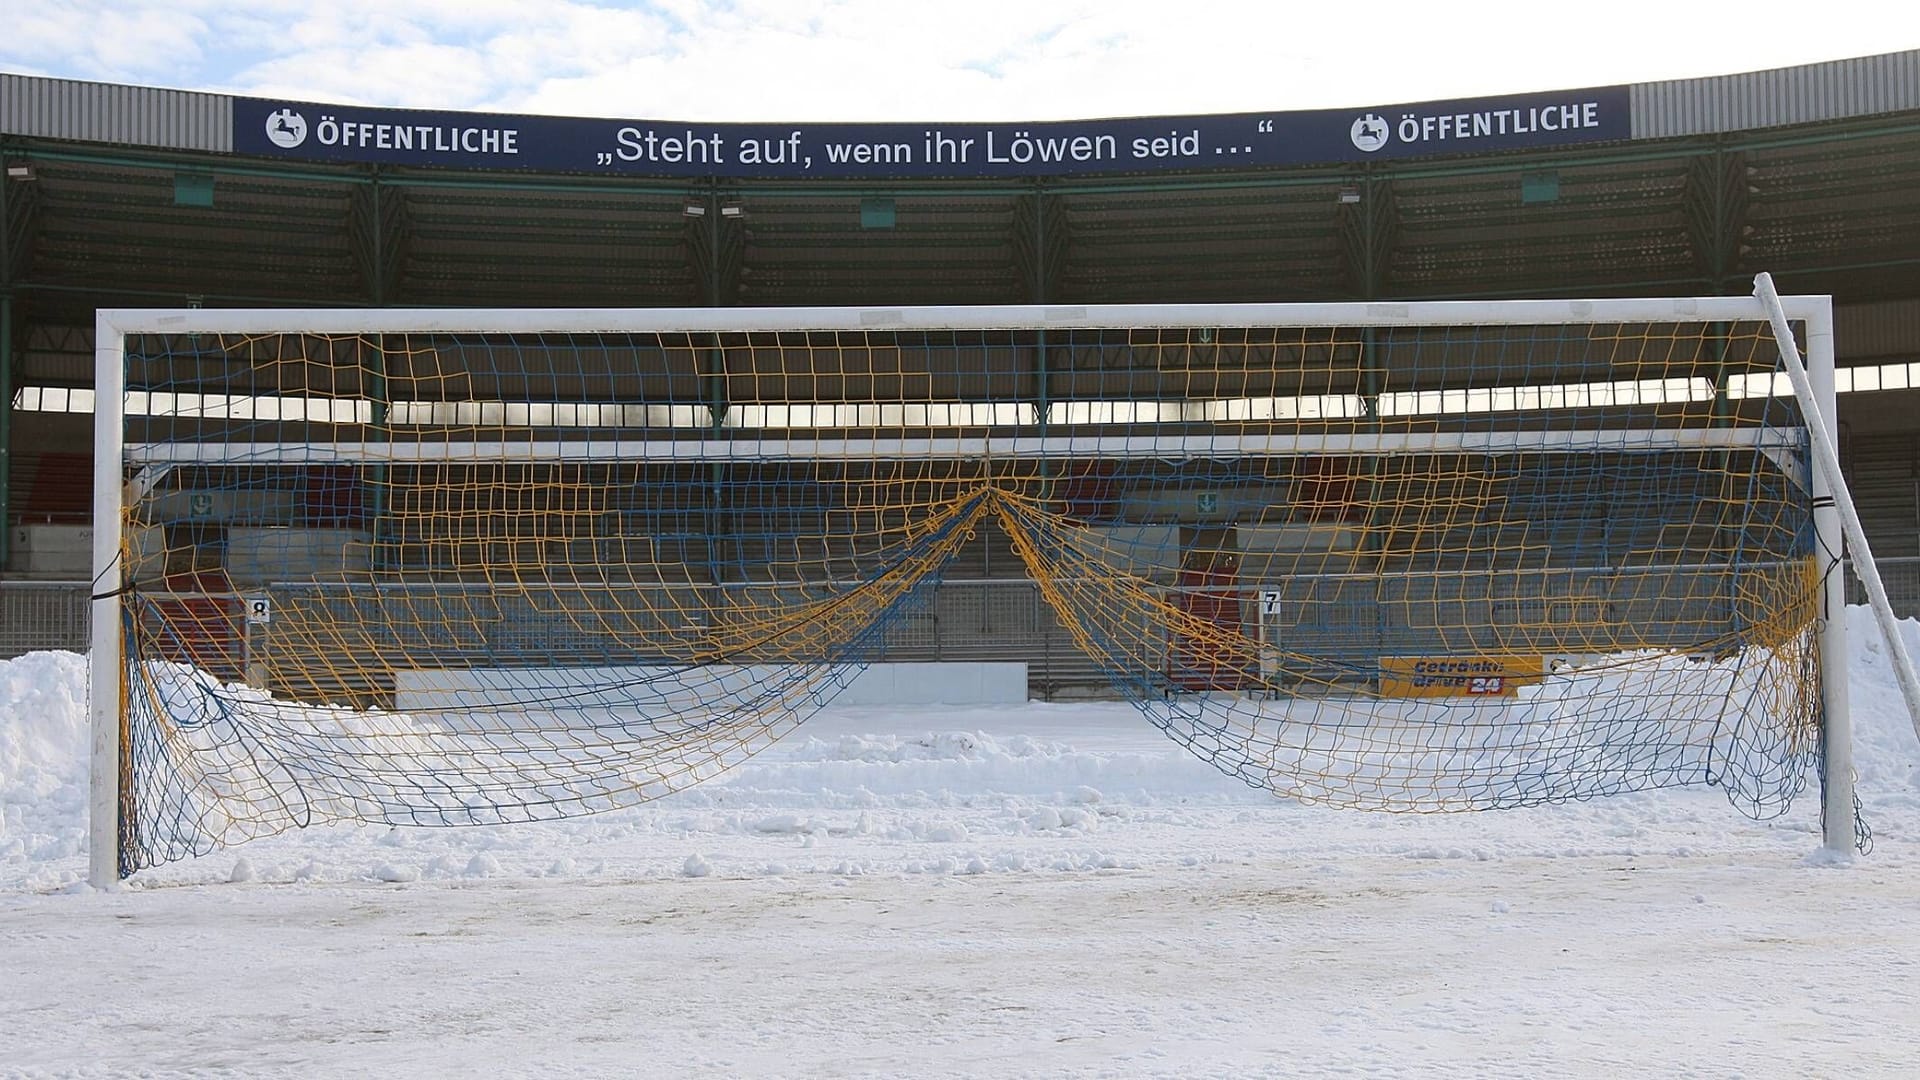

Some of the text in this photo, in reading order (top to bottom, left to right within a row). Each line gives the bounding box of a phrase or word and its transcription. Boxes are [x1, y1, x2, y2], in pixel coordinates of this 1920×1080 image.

[317, 115, 518, 154] ÖFFENTLICHE
[1398, 102, 1599, 143] ÖFFENTLICHE
[597, 127, 724, 166] „Steht
[739, 130, 811, 169] auf,
[825, 143, 912, 164] wenn
[925, 131, 975, 163] ihr
[987, 130, 1116, 163] Löwen
[1132, 129, 1200, 158] seid
[1265, 593, 1277, 612] 7
